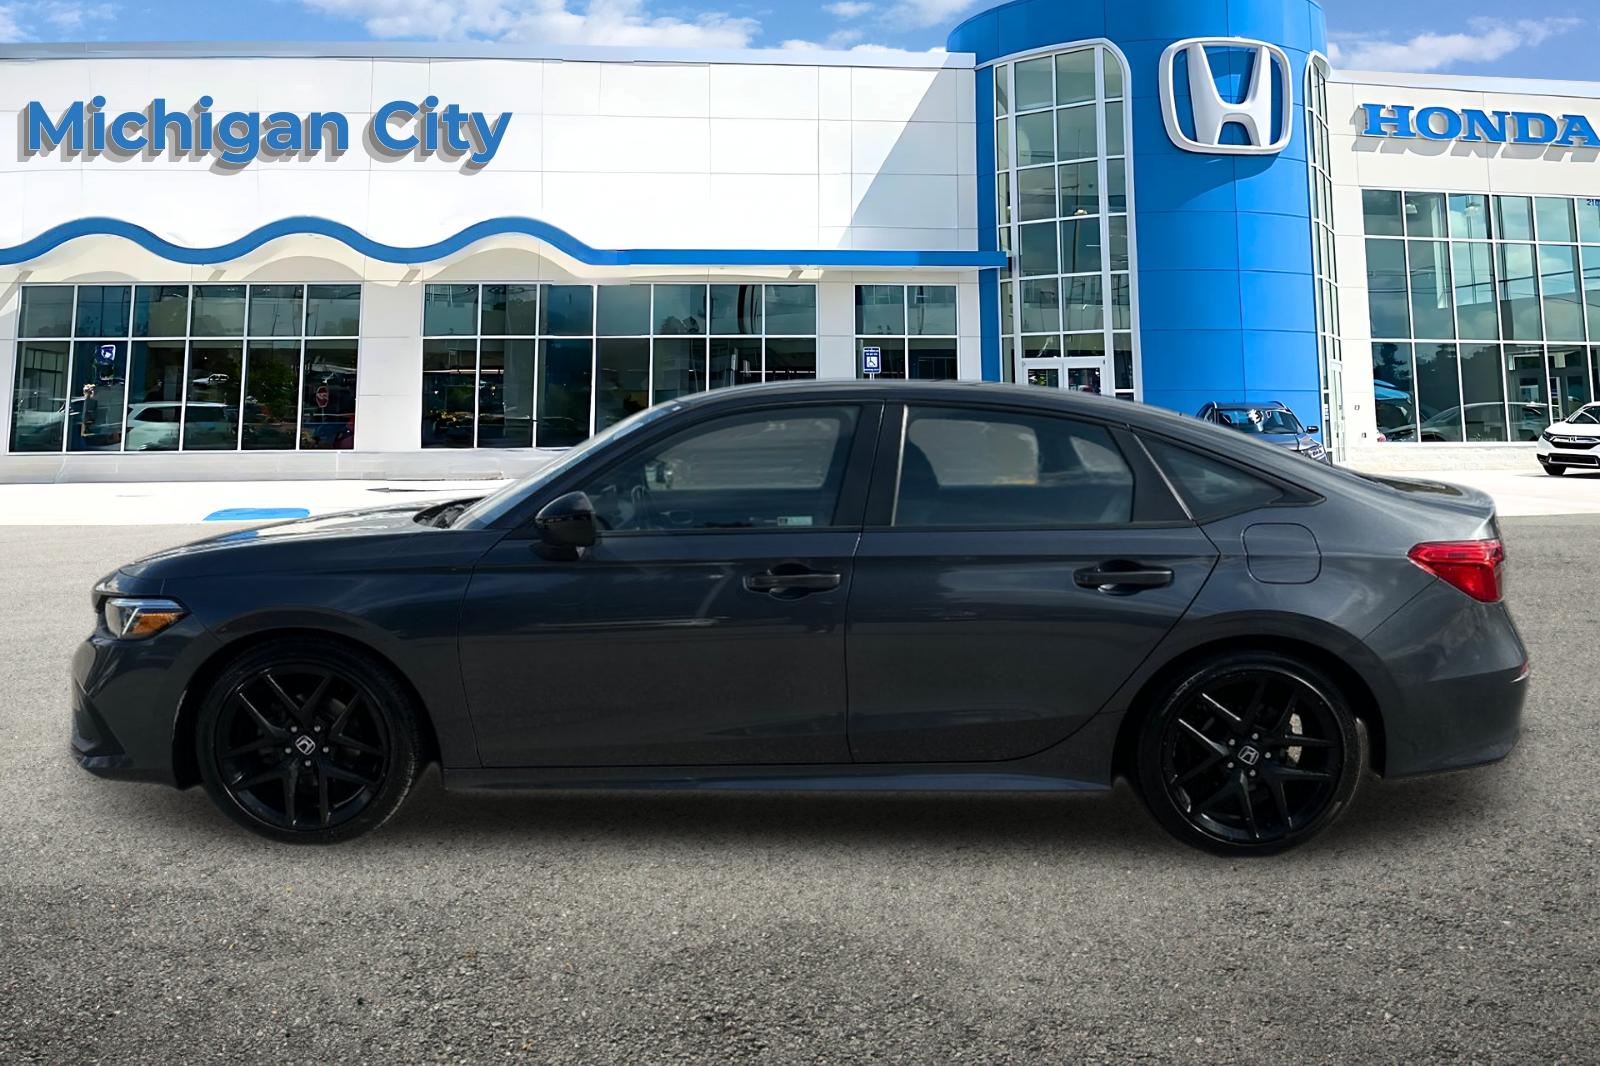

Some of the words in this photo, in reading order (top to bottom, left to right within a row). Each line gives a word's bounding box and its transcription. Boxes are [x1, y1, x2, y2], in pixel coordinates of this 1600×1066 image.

[28, 95, 349, 164] Michigan
[374, 95, 513, 164] City
[1361, 103, 1600, 148] HONDA
